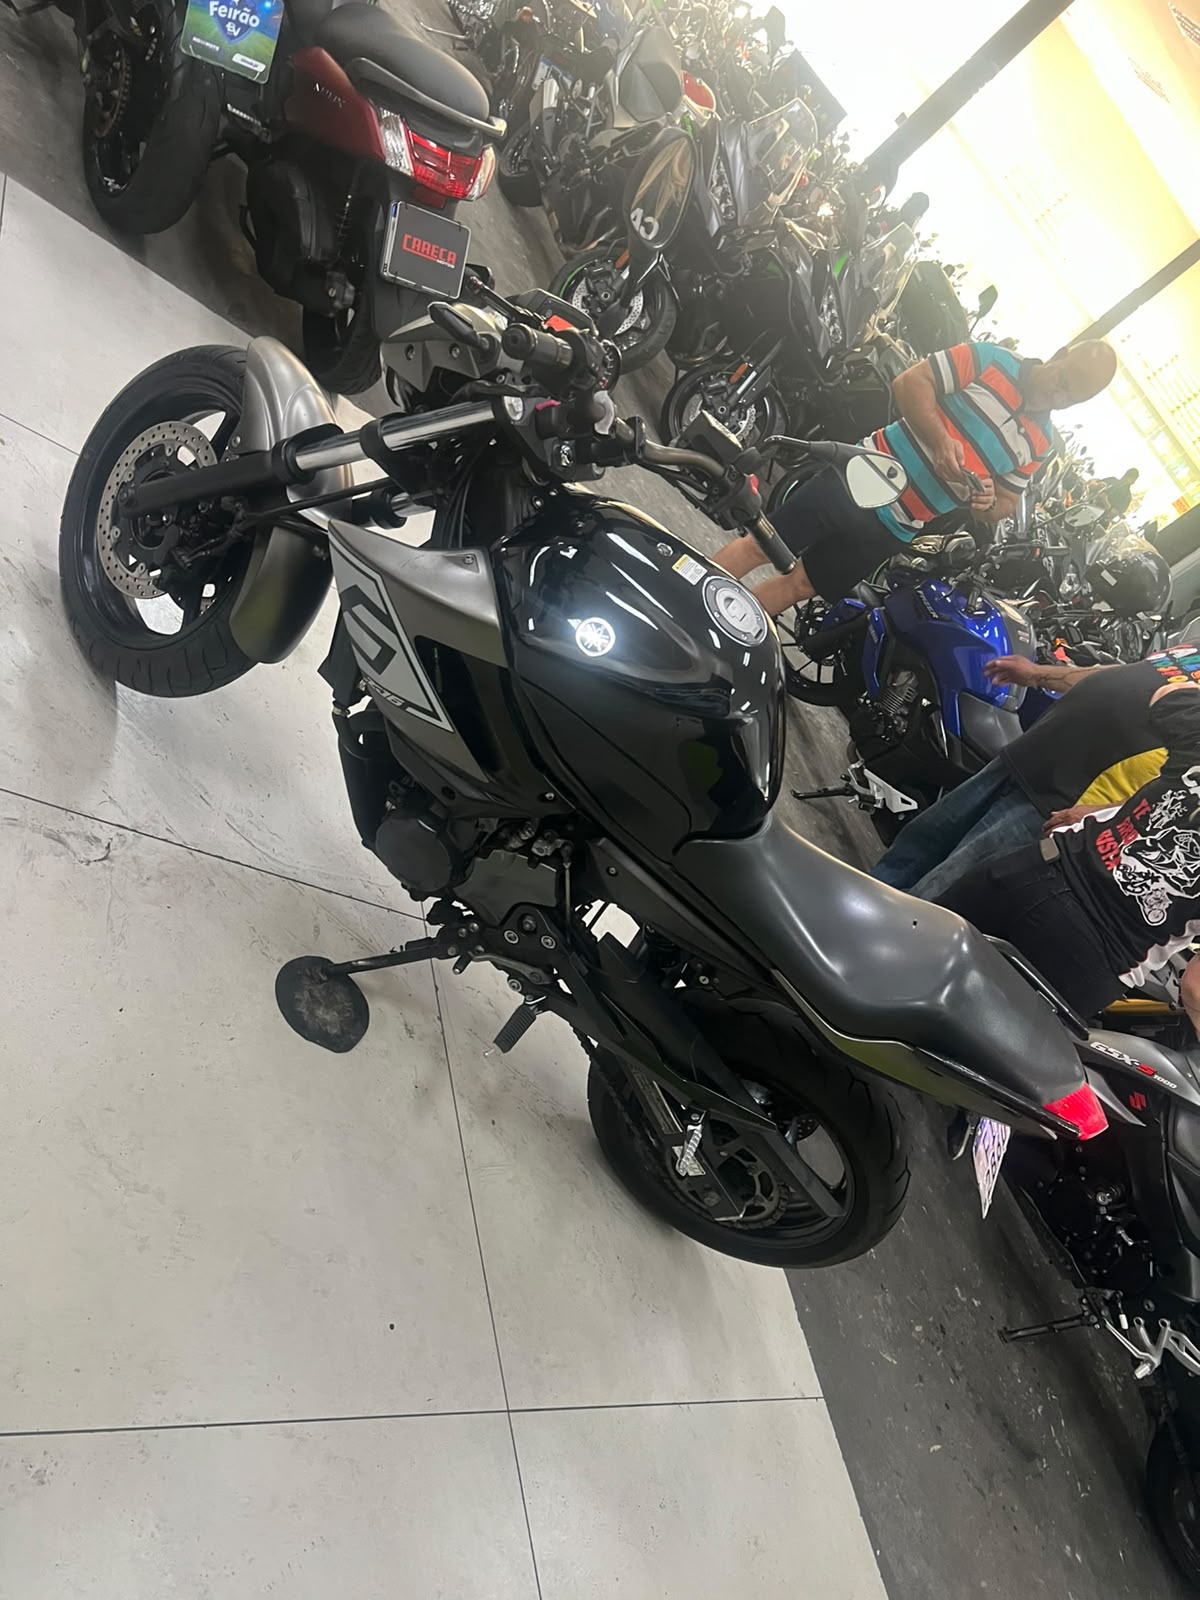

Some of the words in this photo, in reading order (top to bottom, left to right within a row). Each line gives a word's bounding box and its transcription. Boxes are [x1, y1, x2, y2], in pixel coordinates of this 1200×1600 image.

[209, 0, 260, 28] Feirão
[402, 233, 457, 266] CARECA
[1090, 1041, 1157, 1077] GSX-S
[1153, 1074, 1177, 1089] 1000
